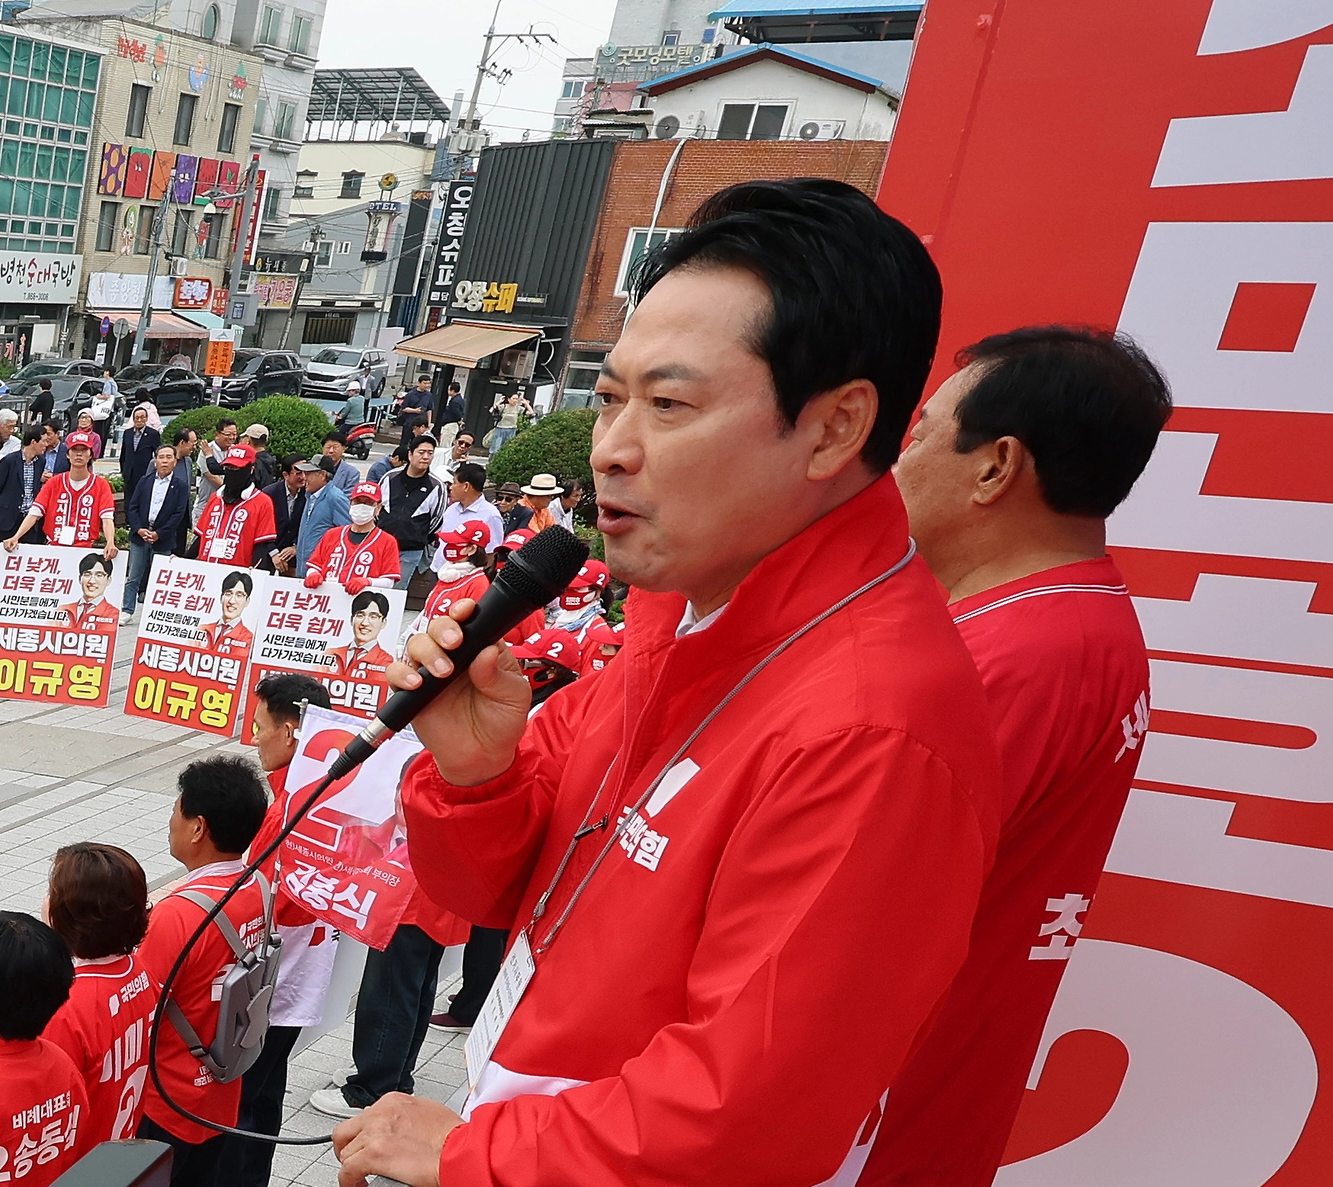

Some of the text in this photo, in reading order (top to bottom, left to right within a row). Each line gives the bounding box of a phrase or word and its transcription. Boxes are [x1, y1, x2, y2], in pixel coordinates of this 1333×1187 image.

[0, 258, 76, 289] 병천순대국밥
[452, 280, 520, 315] 오창슈퍼
[473, 530, 483, 541] 2
[6, 555, 61, 576] 더 낮게,
[2, 575, 73, 595] 더욱 쉽게
[156, 570, 205, 593] 더 낮게,
[596, 574, 606, 585] 2
[0, 594, 58, 609] 시민분들에게
[153, 589, 214, 615] 더욱 쉽게
[272, 591, 332, 615] 더 낮게,
[0, 607, 69, 623] 다가가겠습니다.
[149, 610, 201, 628] 시민분들에게
[267, 612, 343, 638] 더욱 쉽게
[146, 622, 208, 642] 다가가겠습니다.
[263, 633, 326, 652] 시민분들에게
[261, 647, 336, 670] 다가가겠습니다.
[547, 642, 563, 658] 2
[139, 643, 240, 683] 세종시의원
[137, 675, 234, 728] 이규영
[372, 868, 400, 887] 부의장
[285, 859, 378, 931] 김충식
[120, 970, 150, 1003] 국민의힘
[12, 1093, 66, 1130] 비례대표
